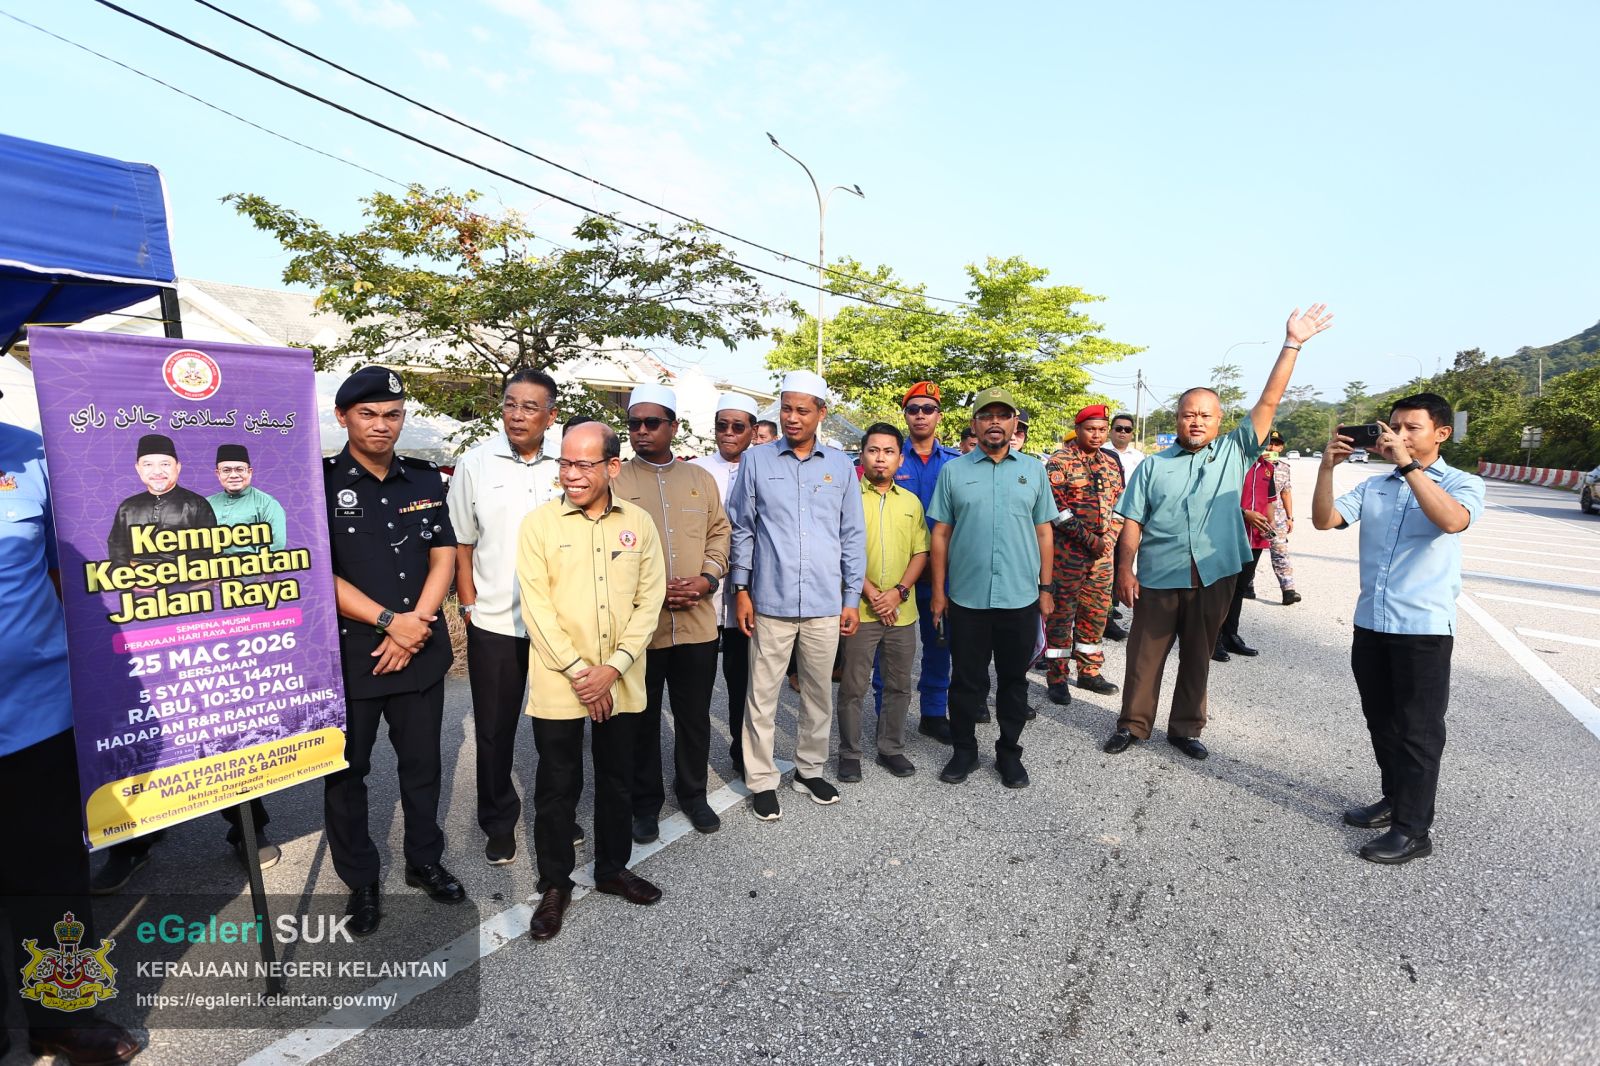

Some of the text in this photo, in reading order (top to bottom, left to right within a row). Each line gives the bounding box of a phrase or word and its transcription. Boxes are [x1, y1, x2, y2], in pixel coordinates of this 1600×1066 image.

[70, 403, 106, 433] راي
[114, 405, 161, 431] جالن
[130, 522, 272, 555] Kempen
[84, 546, 310, 593] Keselamatan
[109, 578, 299, 623] Jalan Raya
[124, 617, 295, 650] PERAYAAN HARI RAYA AIDILFITRI 1447H
[176, 616, 250, 633] SEMPENA MUSIM
[128, 631, 296, 677] 25 MAC 2026
[179, 658, 257, 680] BERSAMAAN
[128, 675, 304, 725] RABU, 10:30 PAGI
[139, 662, 293, 704] 5 SYAWAL 1447H
[96, 688, 338, 752] HADAPAN R&R RANTAU MANIS,
[174, 713, 280, 746] GUA MUSANG
[122, 736, 325, 797] SELAMAT HARI RAYA AIDILFITRI
[161, 753, 297, 798] MAAF ZAHIR & BATIN
[140, 798, 209, 825] Keselamatan
[212, 790, 237, 803] Jalan
[297, 760, 334, 776] Kelantan
[188, 789, 219, 802] Ikhlas
[221, 774, 264, 792] Daripada
